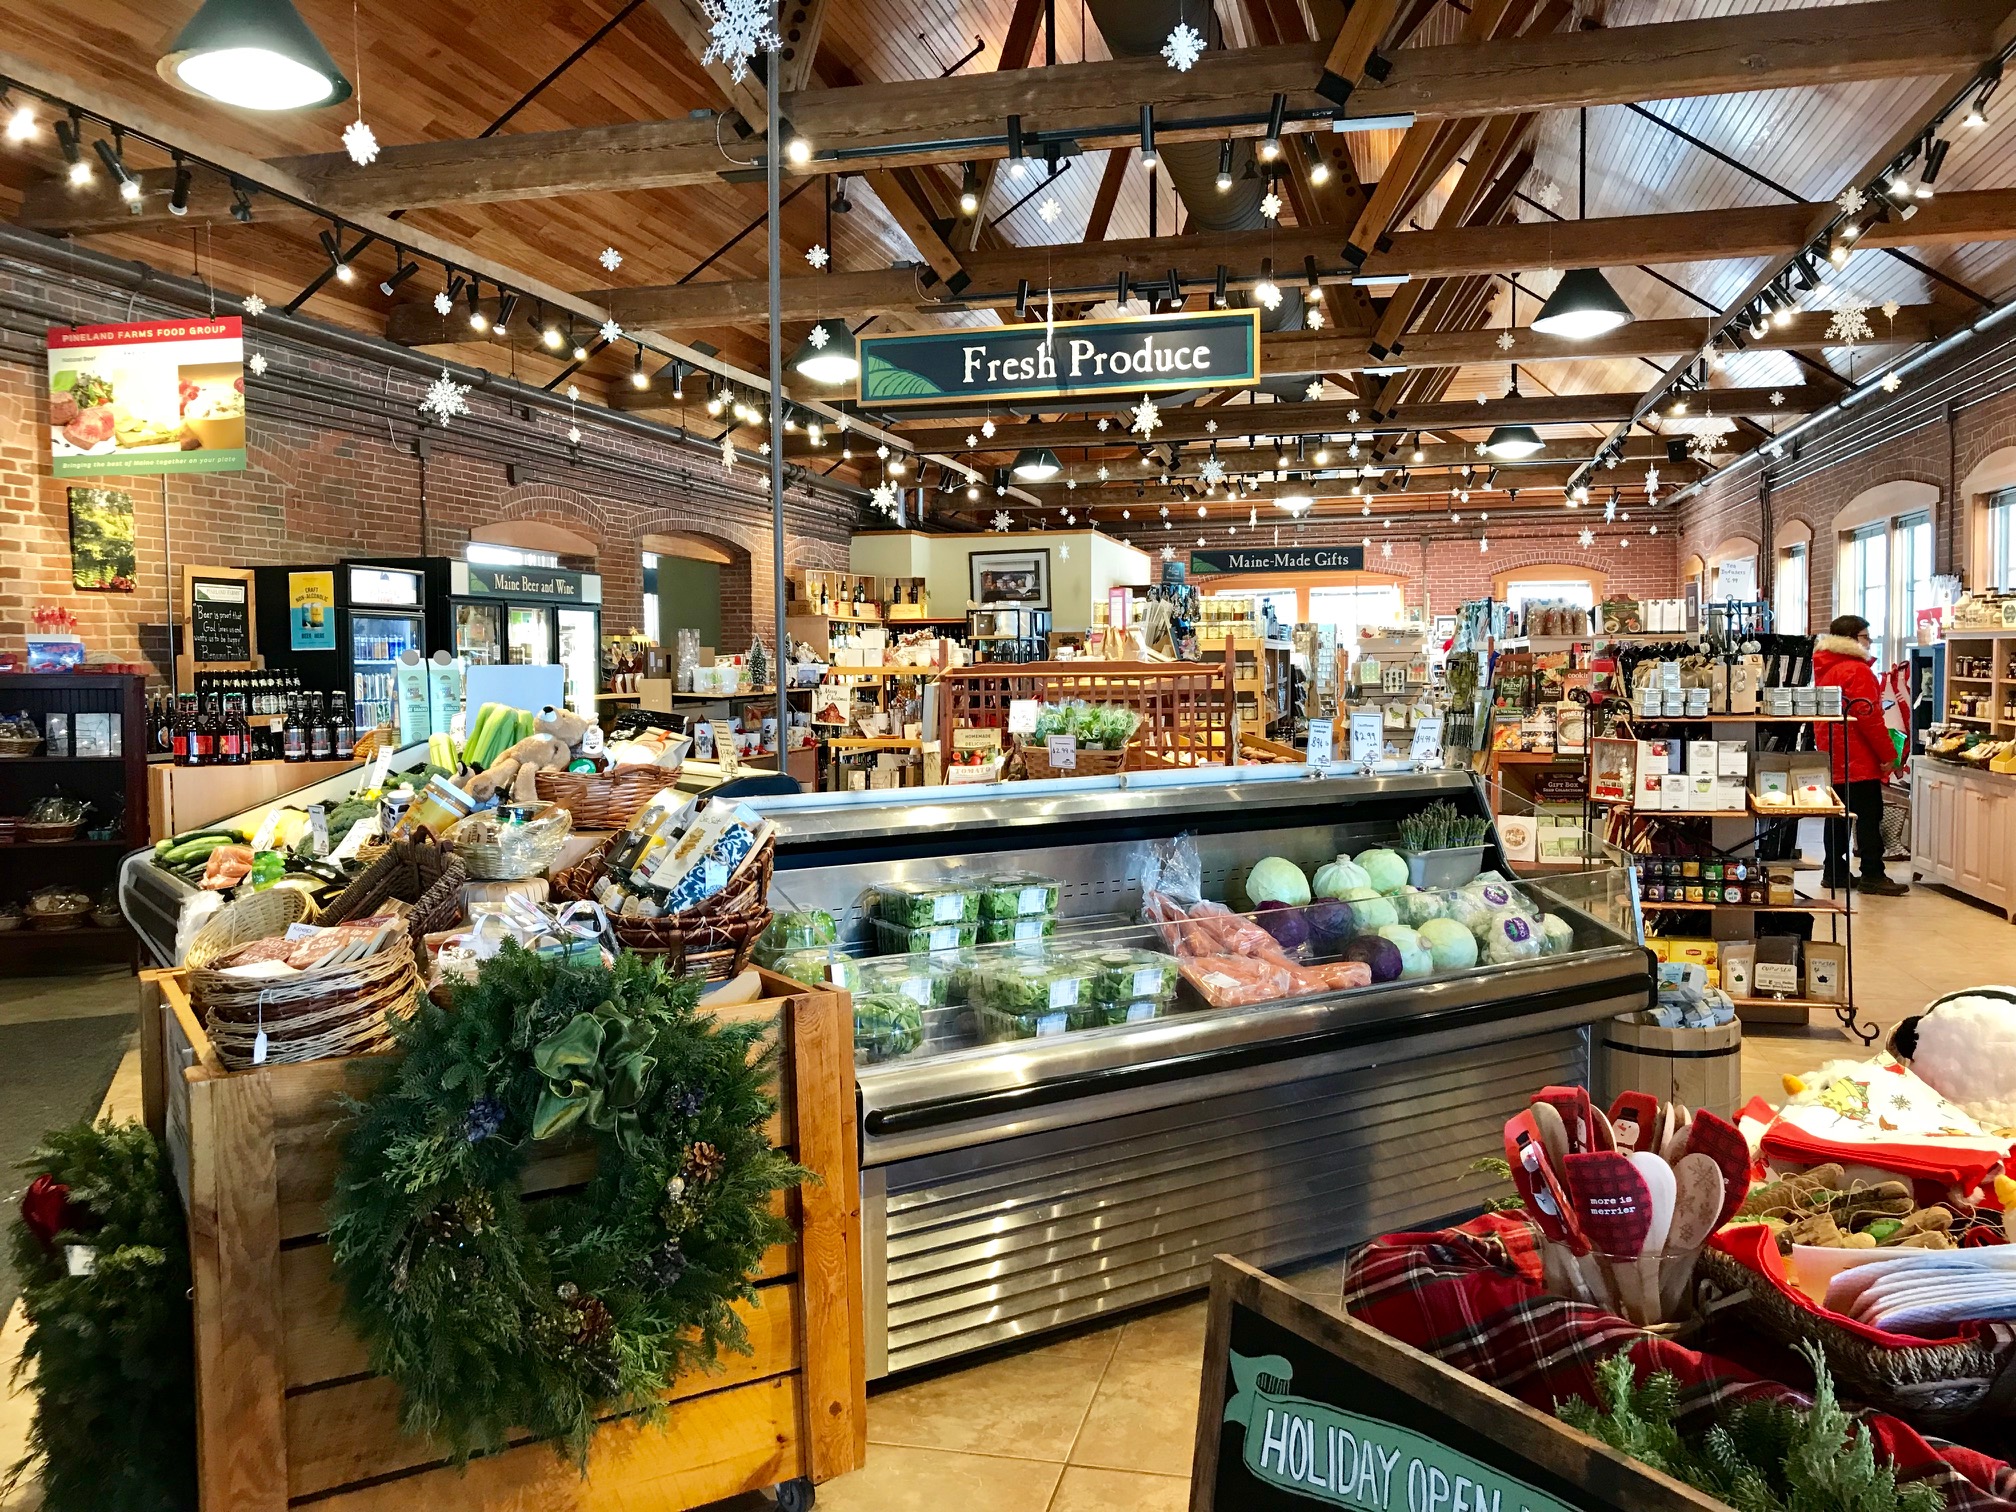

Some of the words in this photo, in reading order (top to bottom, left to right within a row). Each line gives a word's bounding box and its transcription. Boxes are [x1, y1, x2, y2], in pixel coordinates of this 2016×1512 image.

[61, 331, 115, 342] PINELAND
[117, 328, 154, 339] FARMS
[156, 326, 186, 338] FOOD
[189, 324, 227, 335] GROUP
[962, 341, 1057, 383] Fresh
[1068, 335, 1211, 377] Produce
[133, 459, 154, 467] Maine
[156, 458, 187, 467] together
[199, 456, 216, 464] your
[1228, 553, 1312, 568] Maine-Made
[1313, 551, 1350, 567] Gifts
[494, 573, 521, 591] Maine
[521, 575, 540, 592] Beer
[540, 576, 554, 594] and
[555, 578, 575, 595] Wine
[214, 611, 219, 620] is
[232, 611, 243, 620] that
[203, 621, 216, 632] God
[194, 632, 208, 642] wants
[220, 634, 226, 643] be
[1354, 730, 1376, 741] $2.99
[955, 766, 992, 775] TOMATO
[292, 925, 313, 934] Keep
[350, 928, 363, 937] Up
[259, 938, 284, 949] BABY
[310, 940, 340, 950] DEER
[318, 936, 335, 944] OH
[260, 946, 289, 957] COLD
[1590, 1197, 1617, 1206] more
[1618, 1195, 1633, 1204] is
[1590, 1205, 1636, 1216] merrier
[1260, 1408, 1402, 1511] HOLIDAY
